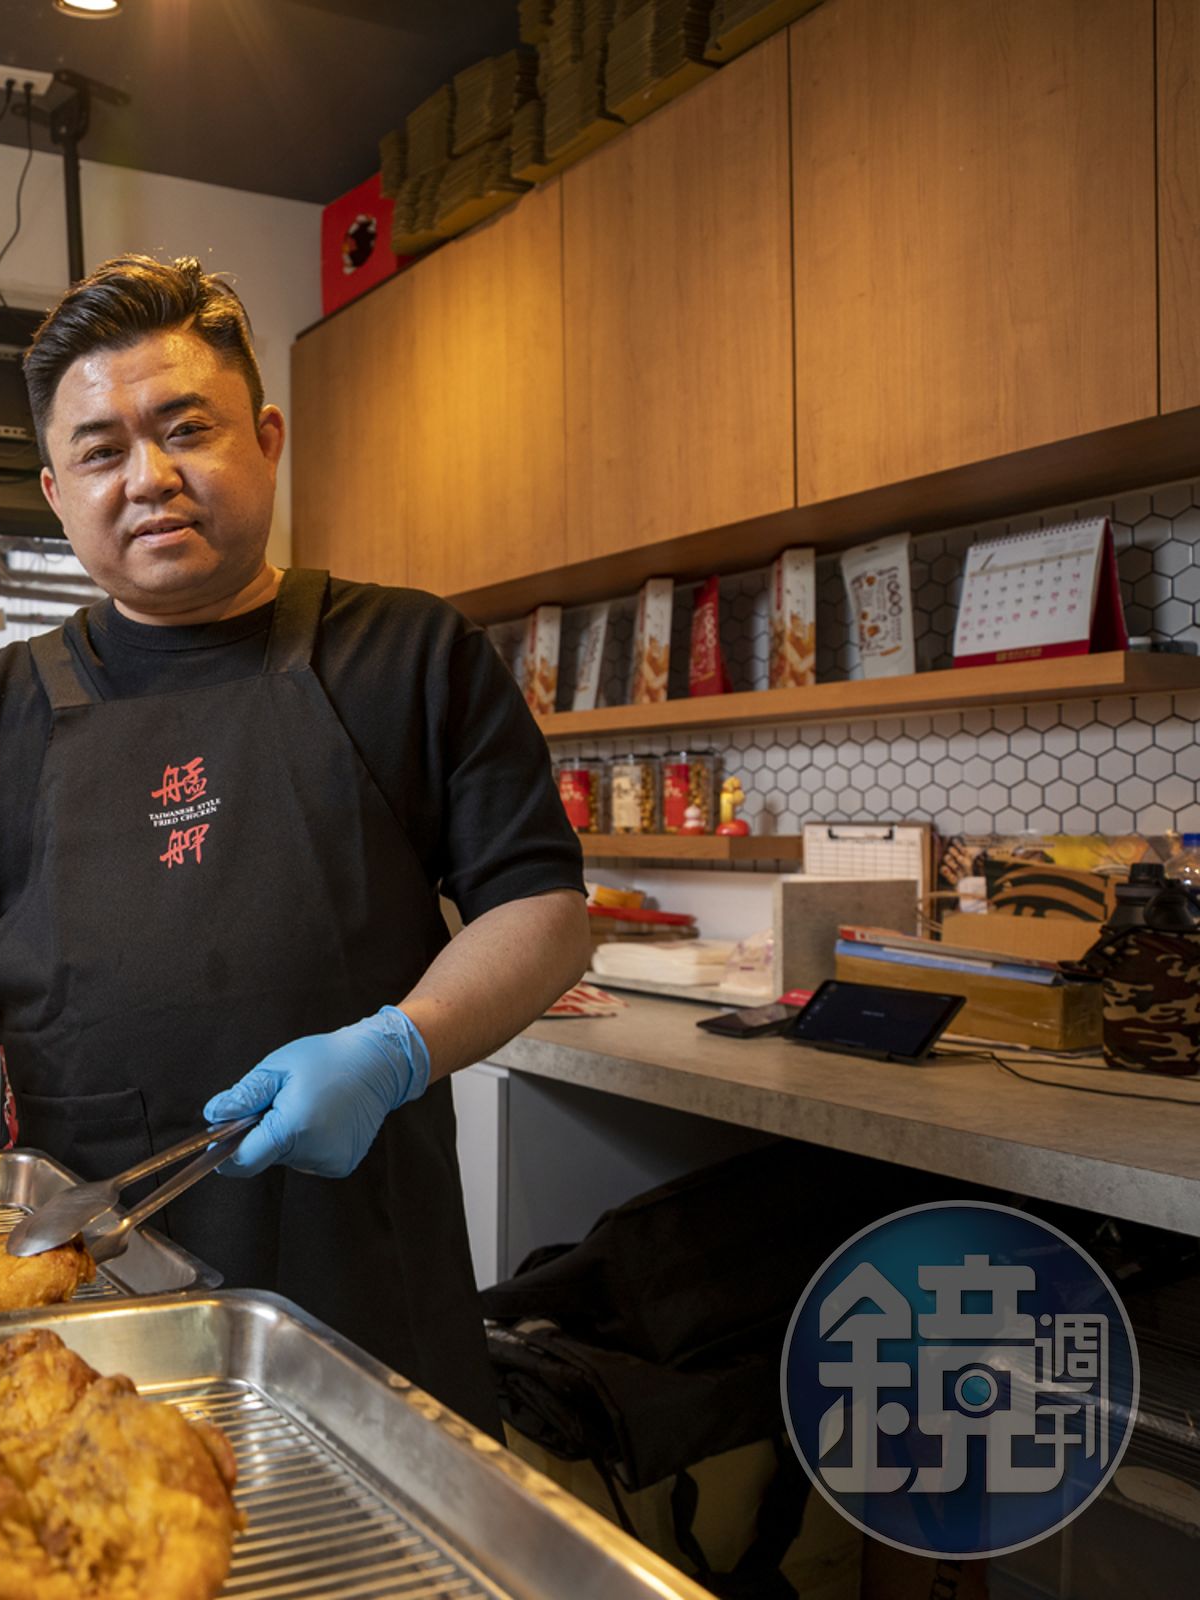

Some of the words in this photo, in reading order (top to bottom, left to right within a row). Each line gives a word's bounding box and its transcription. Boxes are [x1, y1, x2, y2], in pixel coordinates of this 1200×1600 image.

[149, 805, 196, 821] TAIWANESE
[197, 798, 222, 811] STYLE
[153, 817, 179, 828] FRIED
[180, 806, 217, 822] CHICKEN
